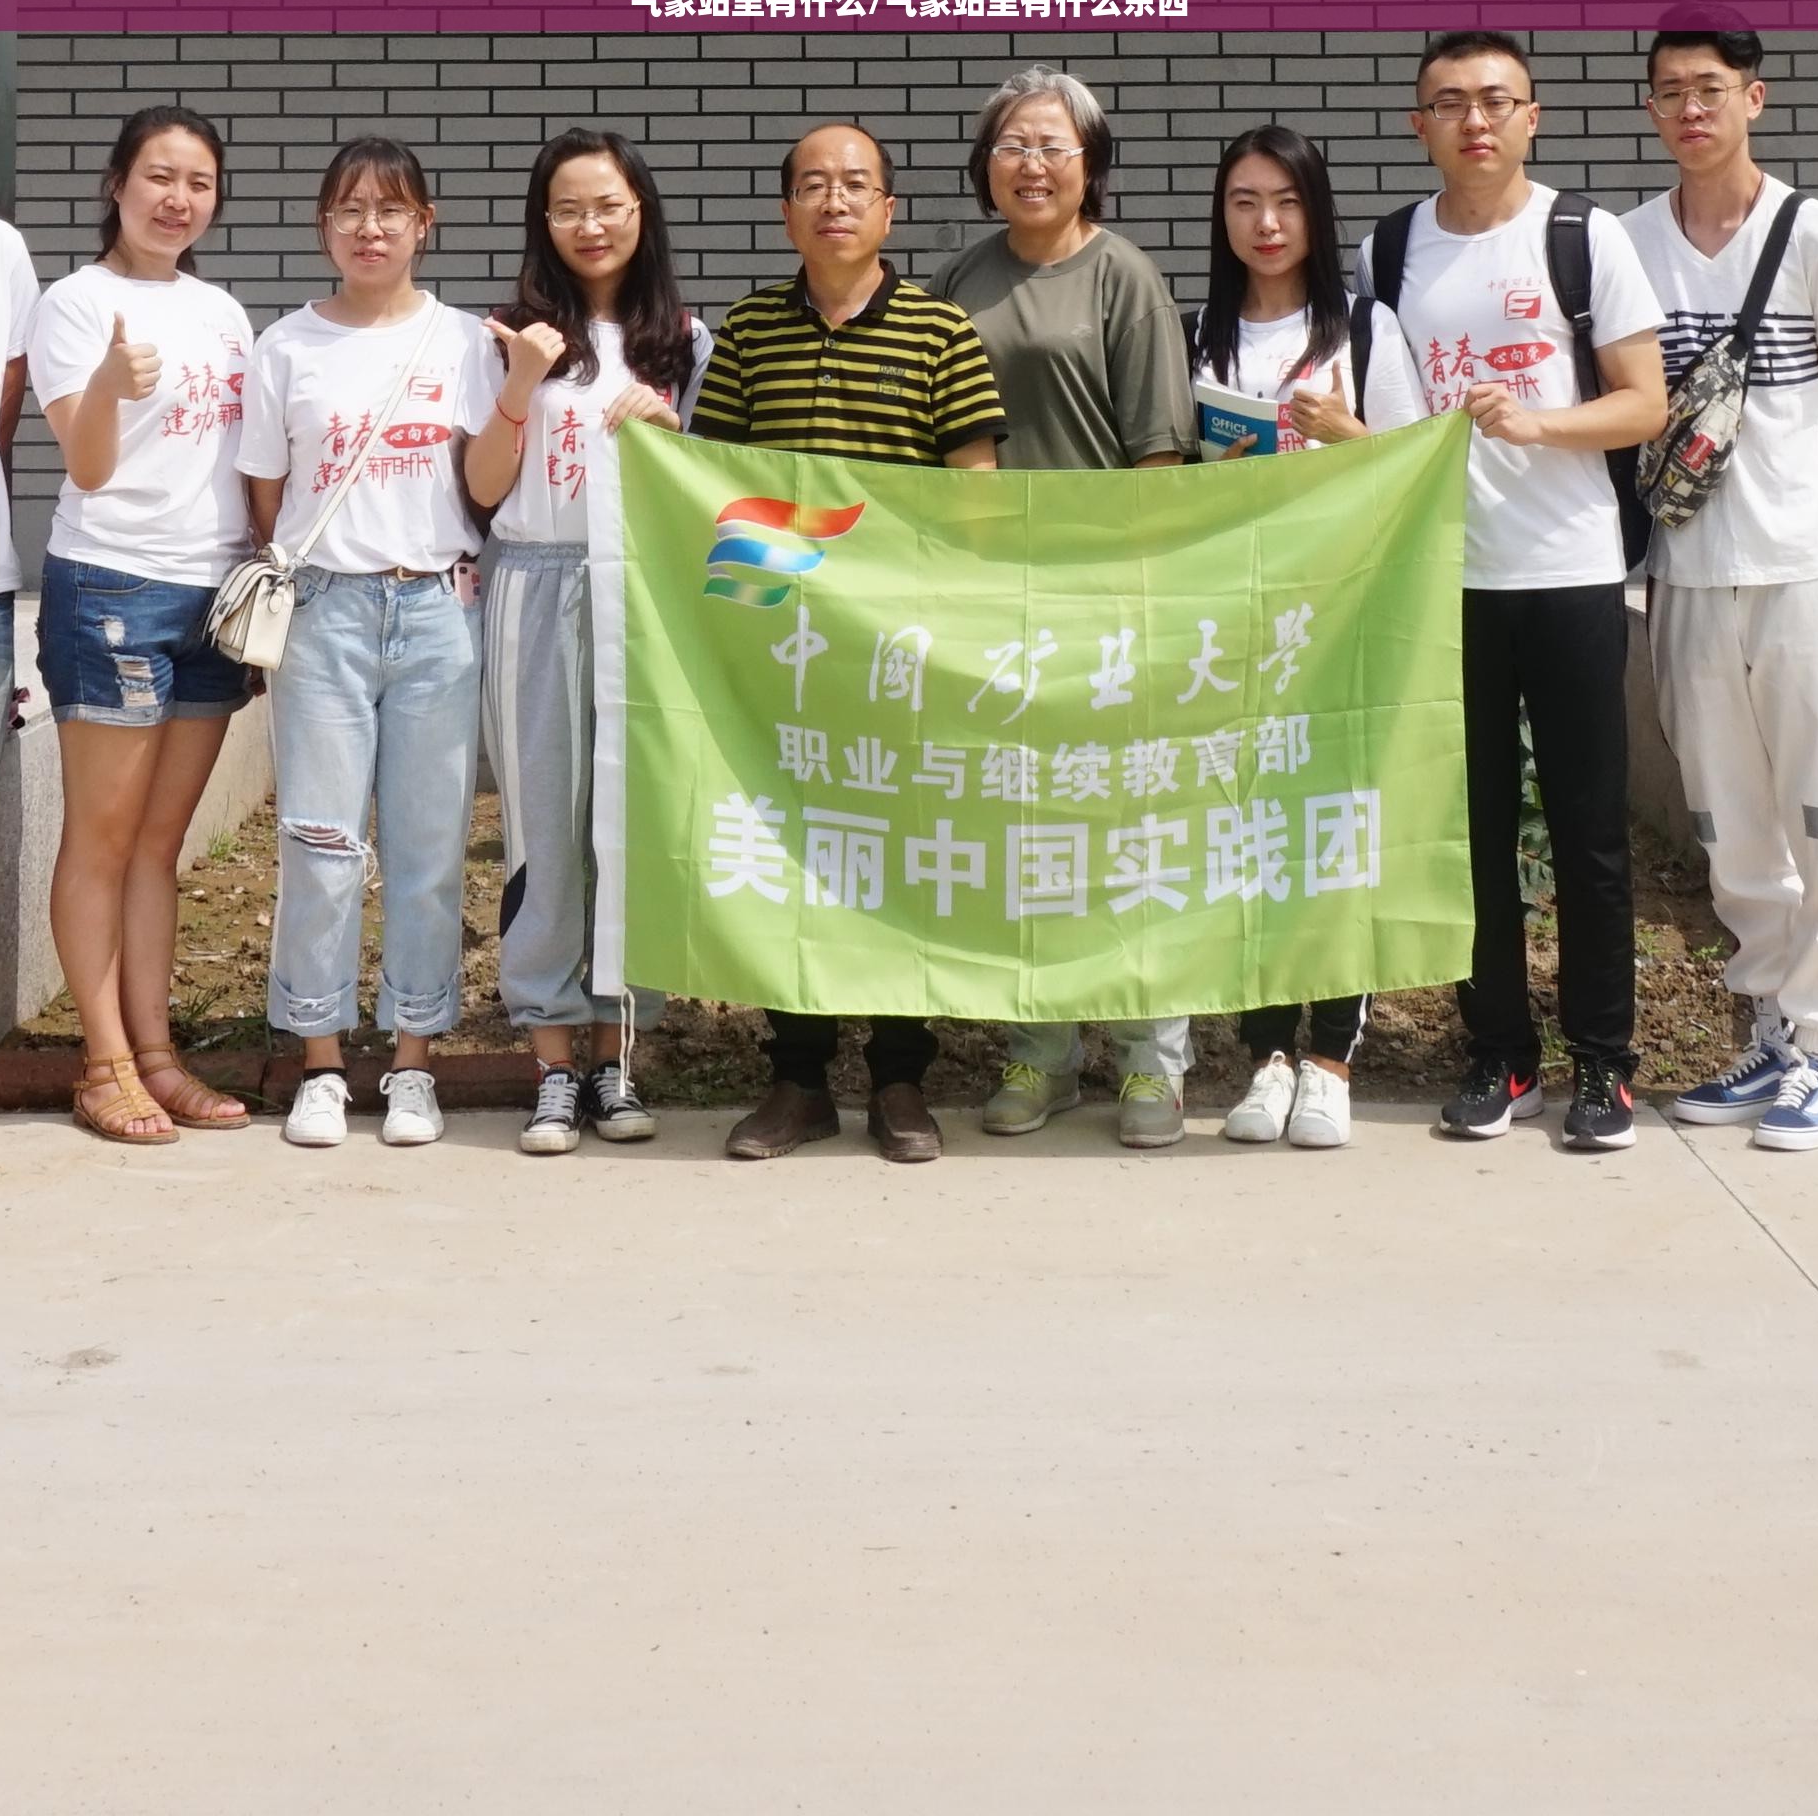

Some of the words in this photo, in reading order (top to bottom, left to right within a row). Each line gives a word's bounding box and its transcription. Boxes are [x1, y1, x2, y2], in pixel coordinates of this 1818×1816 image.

[174, 361, 228, 405] 青春
[1423, 331, 1483, 385] 青春
[1211, 416, 1248, 434] OFFICE
[776, 713, 1312, 803] 职业与继续教育部
[707, 788, 1382, 921] 美丽中国实践团
